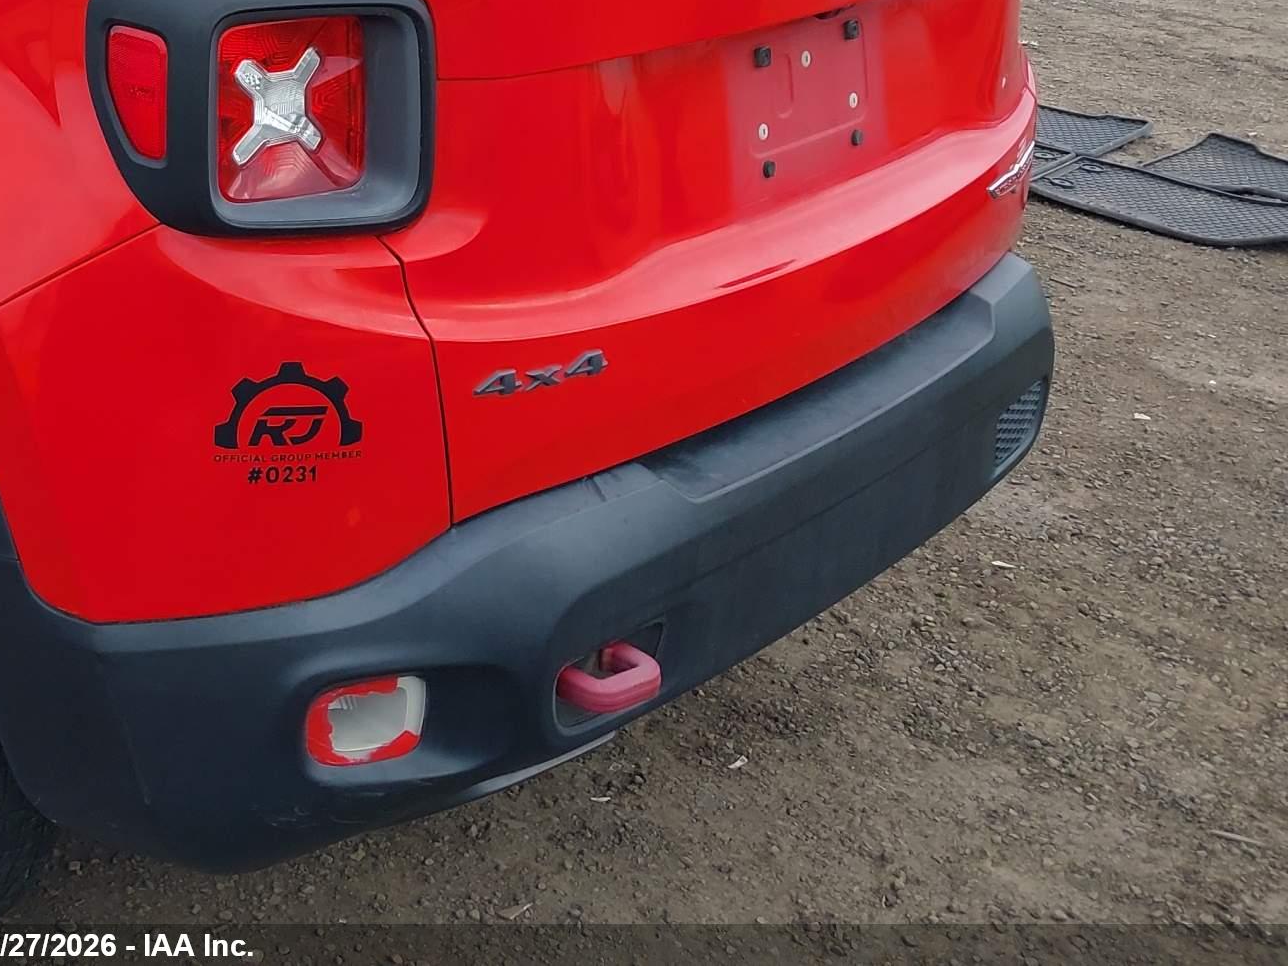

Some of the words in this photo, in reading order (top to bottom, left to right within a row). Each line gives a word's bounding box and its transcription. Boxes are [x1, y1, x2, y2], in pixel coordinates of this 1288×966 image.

[248, 405, 329, 447] RJ
[213, 453, 267, 463] OFFICIAL
[270, 452, 313, 462] GROUP
[314, 450, 362, 460] MEMBER
[248, 465, 318, 484] #0231
